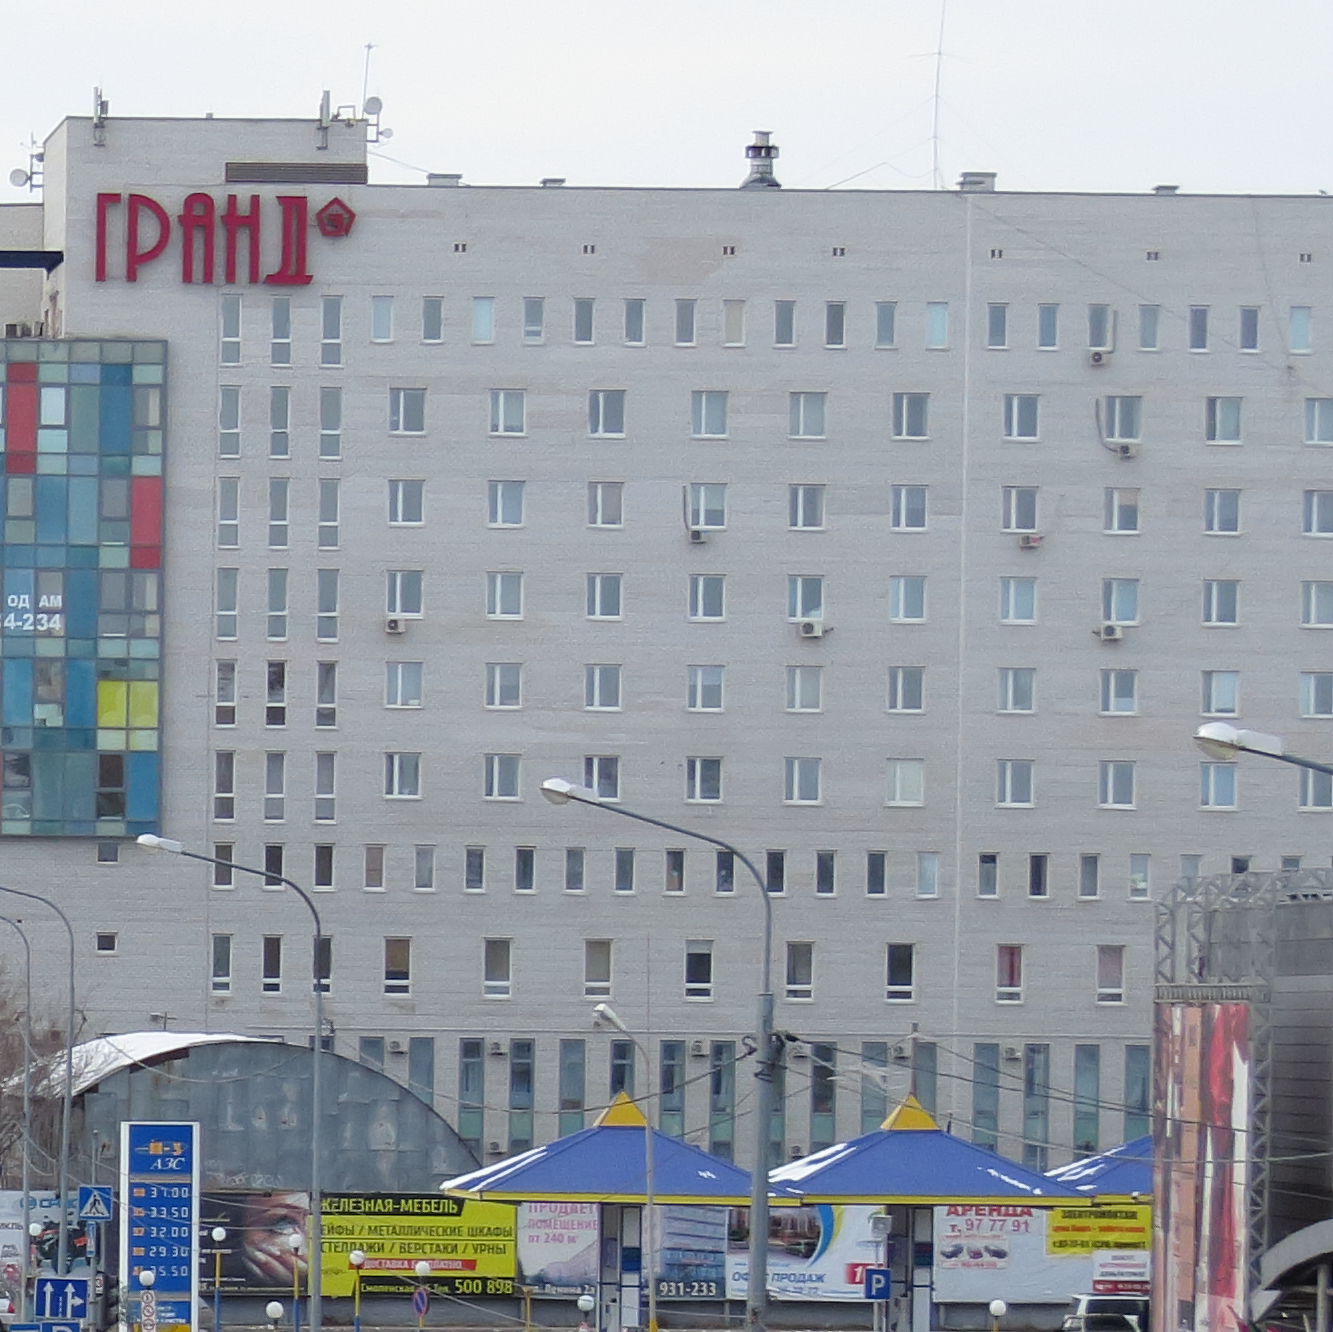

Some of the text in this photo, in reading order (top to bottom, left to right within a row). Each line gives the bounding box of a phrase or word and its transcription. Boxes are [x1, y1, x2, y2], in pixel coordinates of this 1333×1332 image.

[95, 193, 313, 285] ГРАНД
[946, 1205, 1033, 1217] АРЕНДА
[321, 1224, 355, 1237] ЕЙФЫ
[367, 1225, 463, 1238] МЕТАЛЛИЧЕСКИЕ
[467, 1225, 513, 1239] ШКАФЫ
[528, 1219, 598, 1230] ПОМЕЩЕНИЕ
[399, 1242, 459, 1255] ВЕРСТАКИ
[472, 1242, 507, 1256] УРНЫ
[364, 1260, 408, 1269] ДОСТАВКА
[771, 1272, 826, 1284] ПРОДАЖ
[454, 1279, 482, 1294] 500
[486, 1279, 513, 1294] 898
[659, 1281, 717, 1296] 931-233
